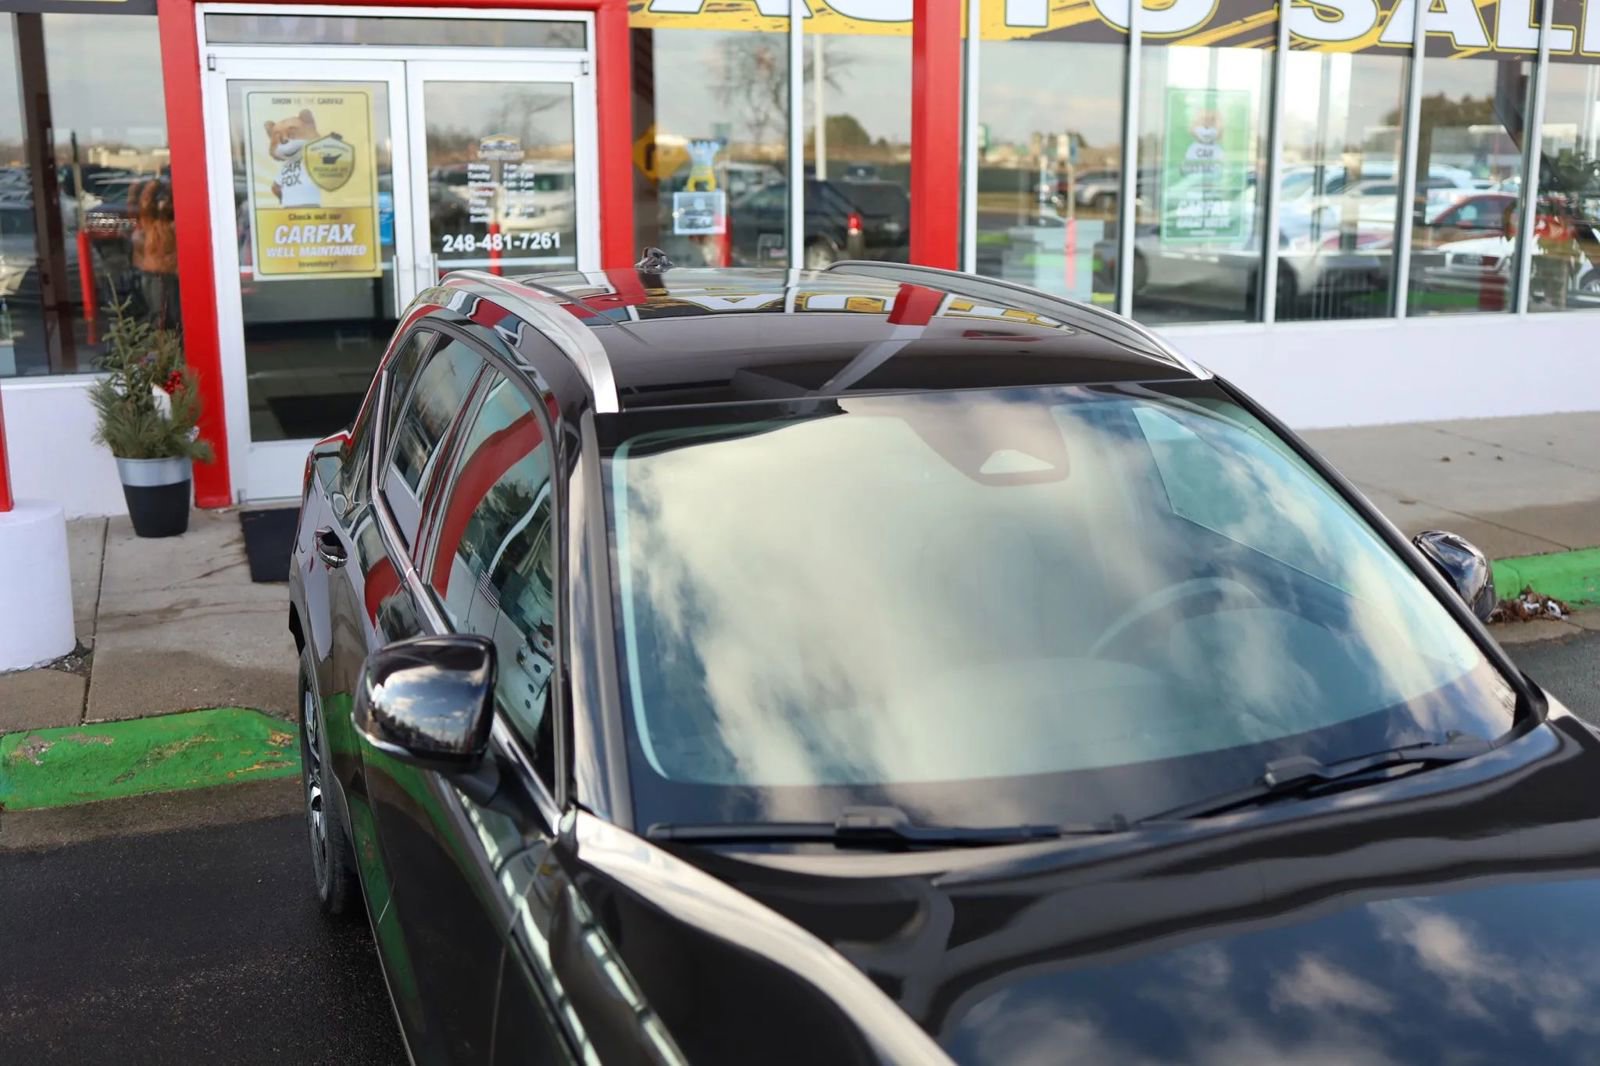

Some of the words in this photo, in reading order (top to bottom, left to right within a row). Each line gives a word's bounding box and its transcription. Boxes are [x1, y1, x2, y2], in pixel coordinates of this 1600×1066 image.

[274, 224, 356, 244] CARFAX
[442, 232, 561, 252] 248-481-7261
[266, 247, 295, 257] WELL
[299, 245, 367, 257] MAINTAINED
